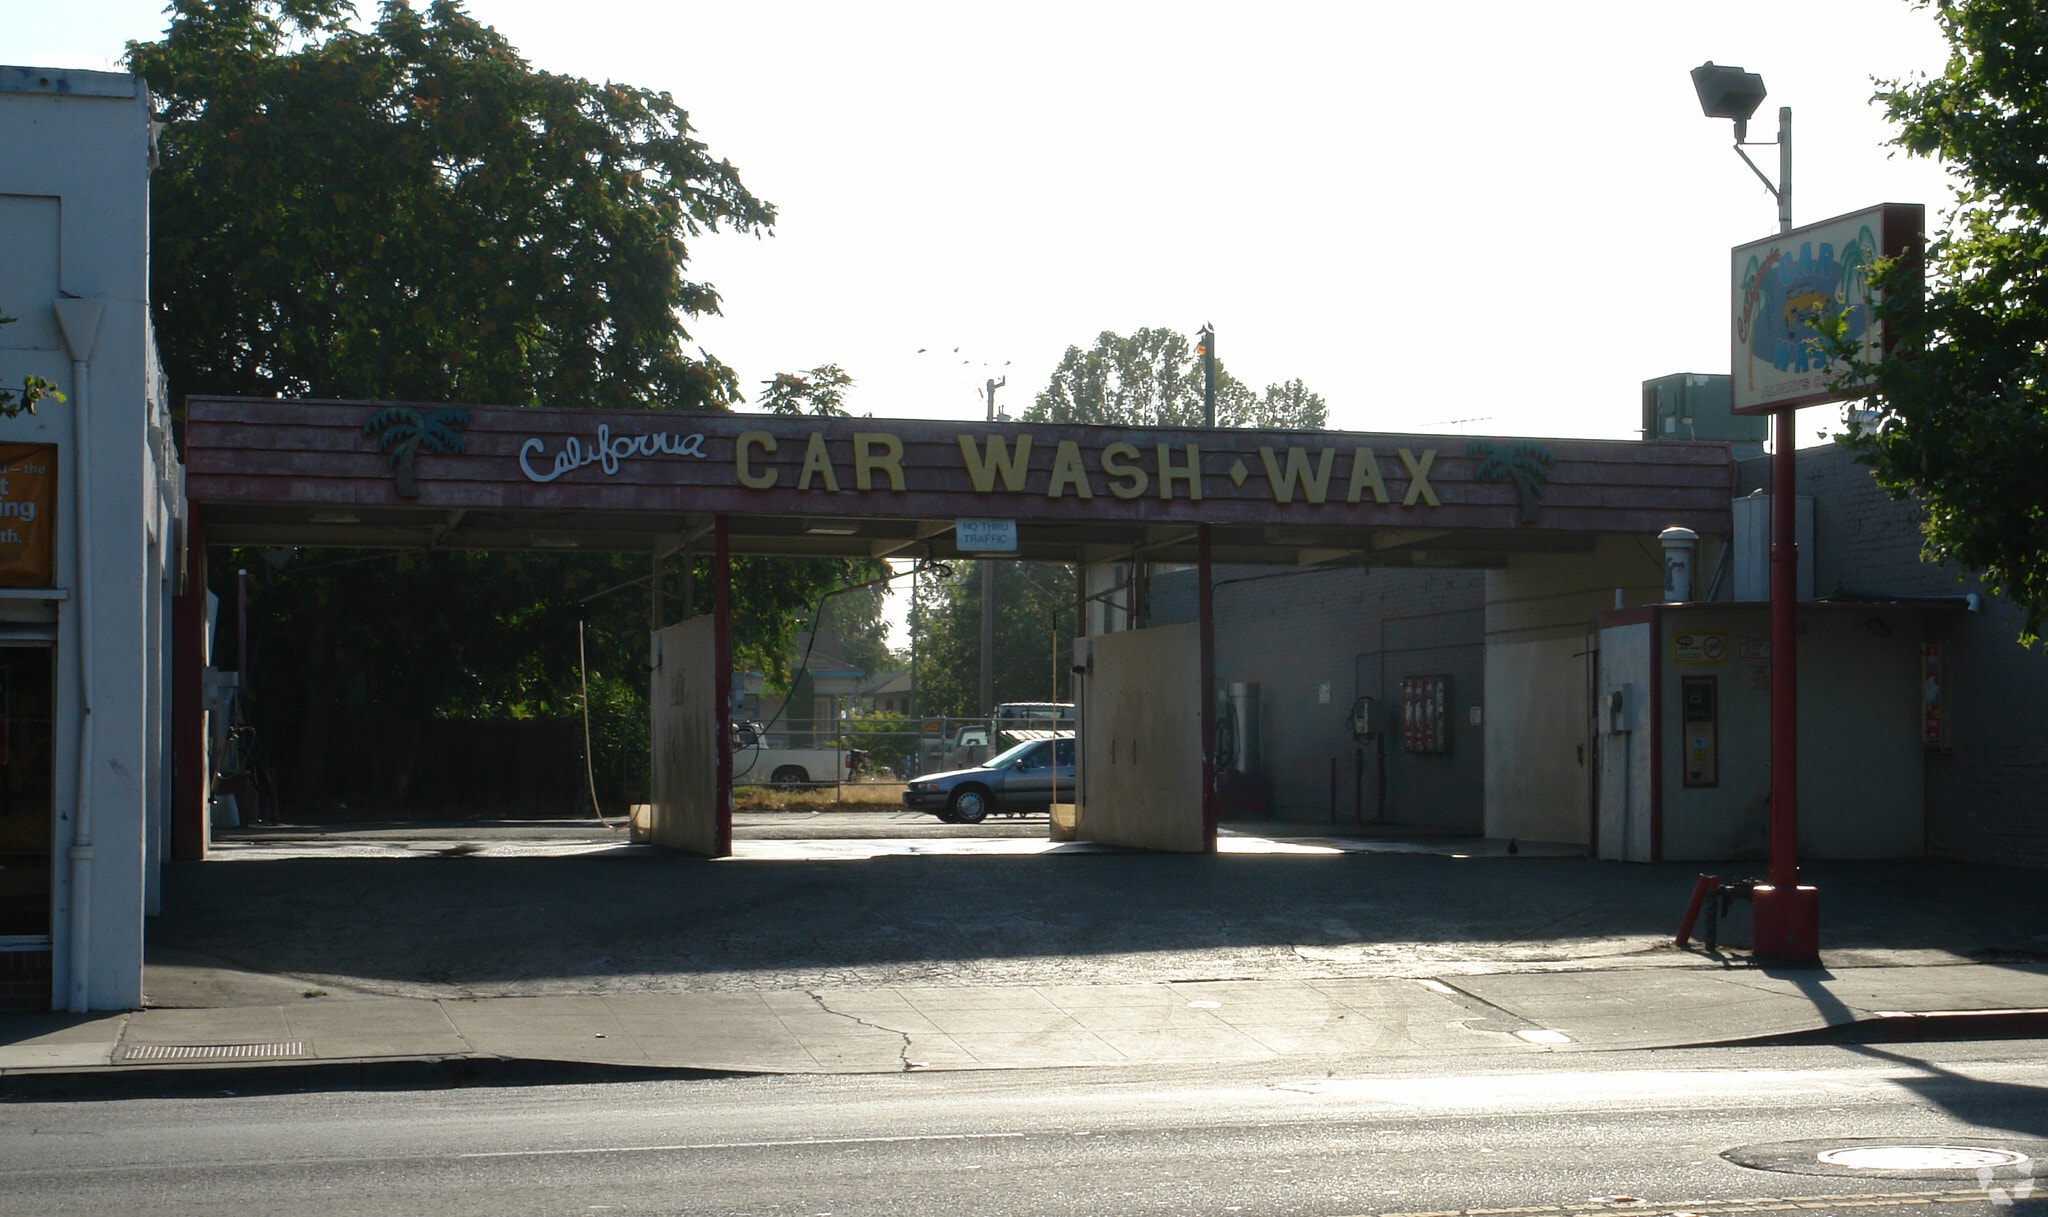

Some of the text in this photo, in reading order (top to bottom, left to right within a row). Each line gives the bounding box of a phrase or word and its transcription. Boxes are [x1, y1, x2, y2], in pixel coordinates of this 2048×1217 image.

[1777, 241, 1835, 285] CAR
[1761, 377, 1811, 399] ALWAYS
[25, 464, 46, 474] the
[519, 423, 1441, 507] California CAR WASH WAX
[962, 522, 1009, 531] NO THRU
[964, 534, 1007, 544] TRAFFIC
